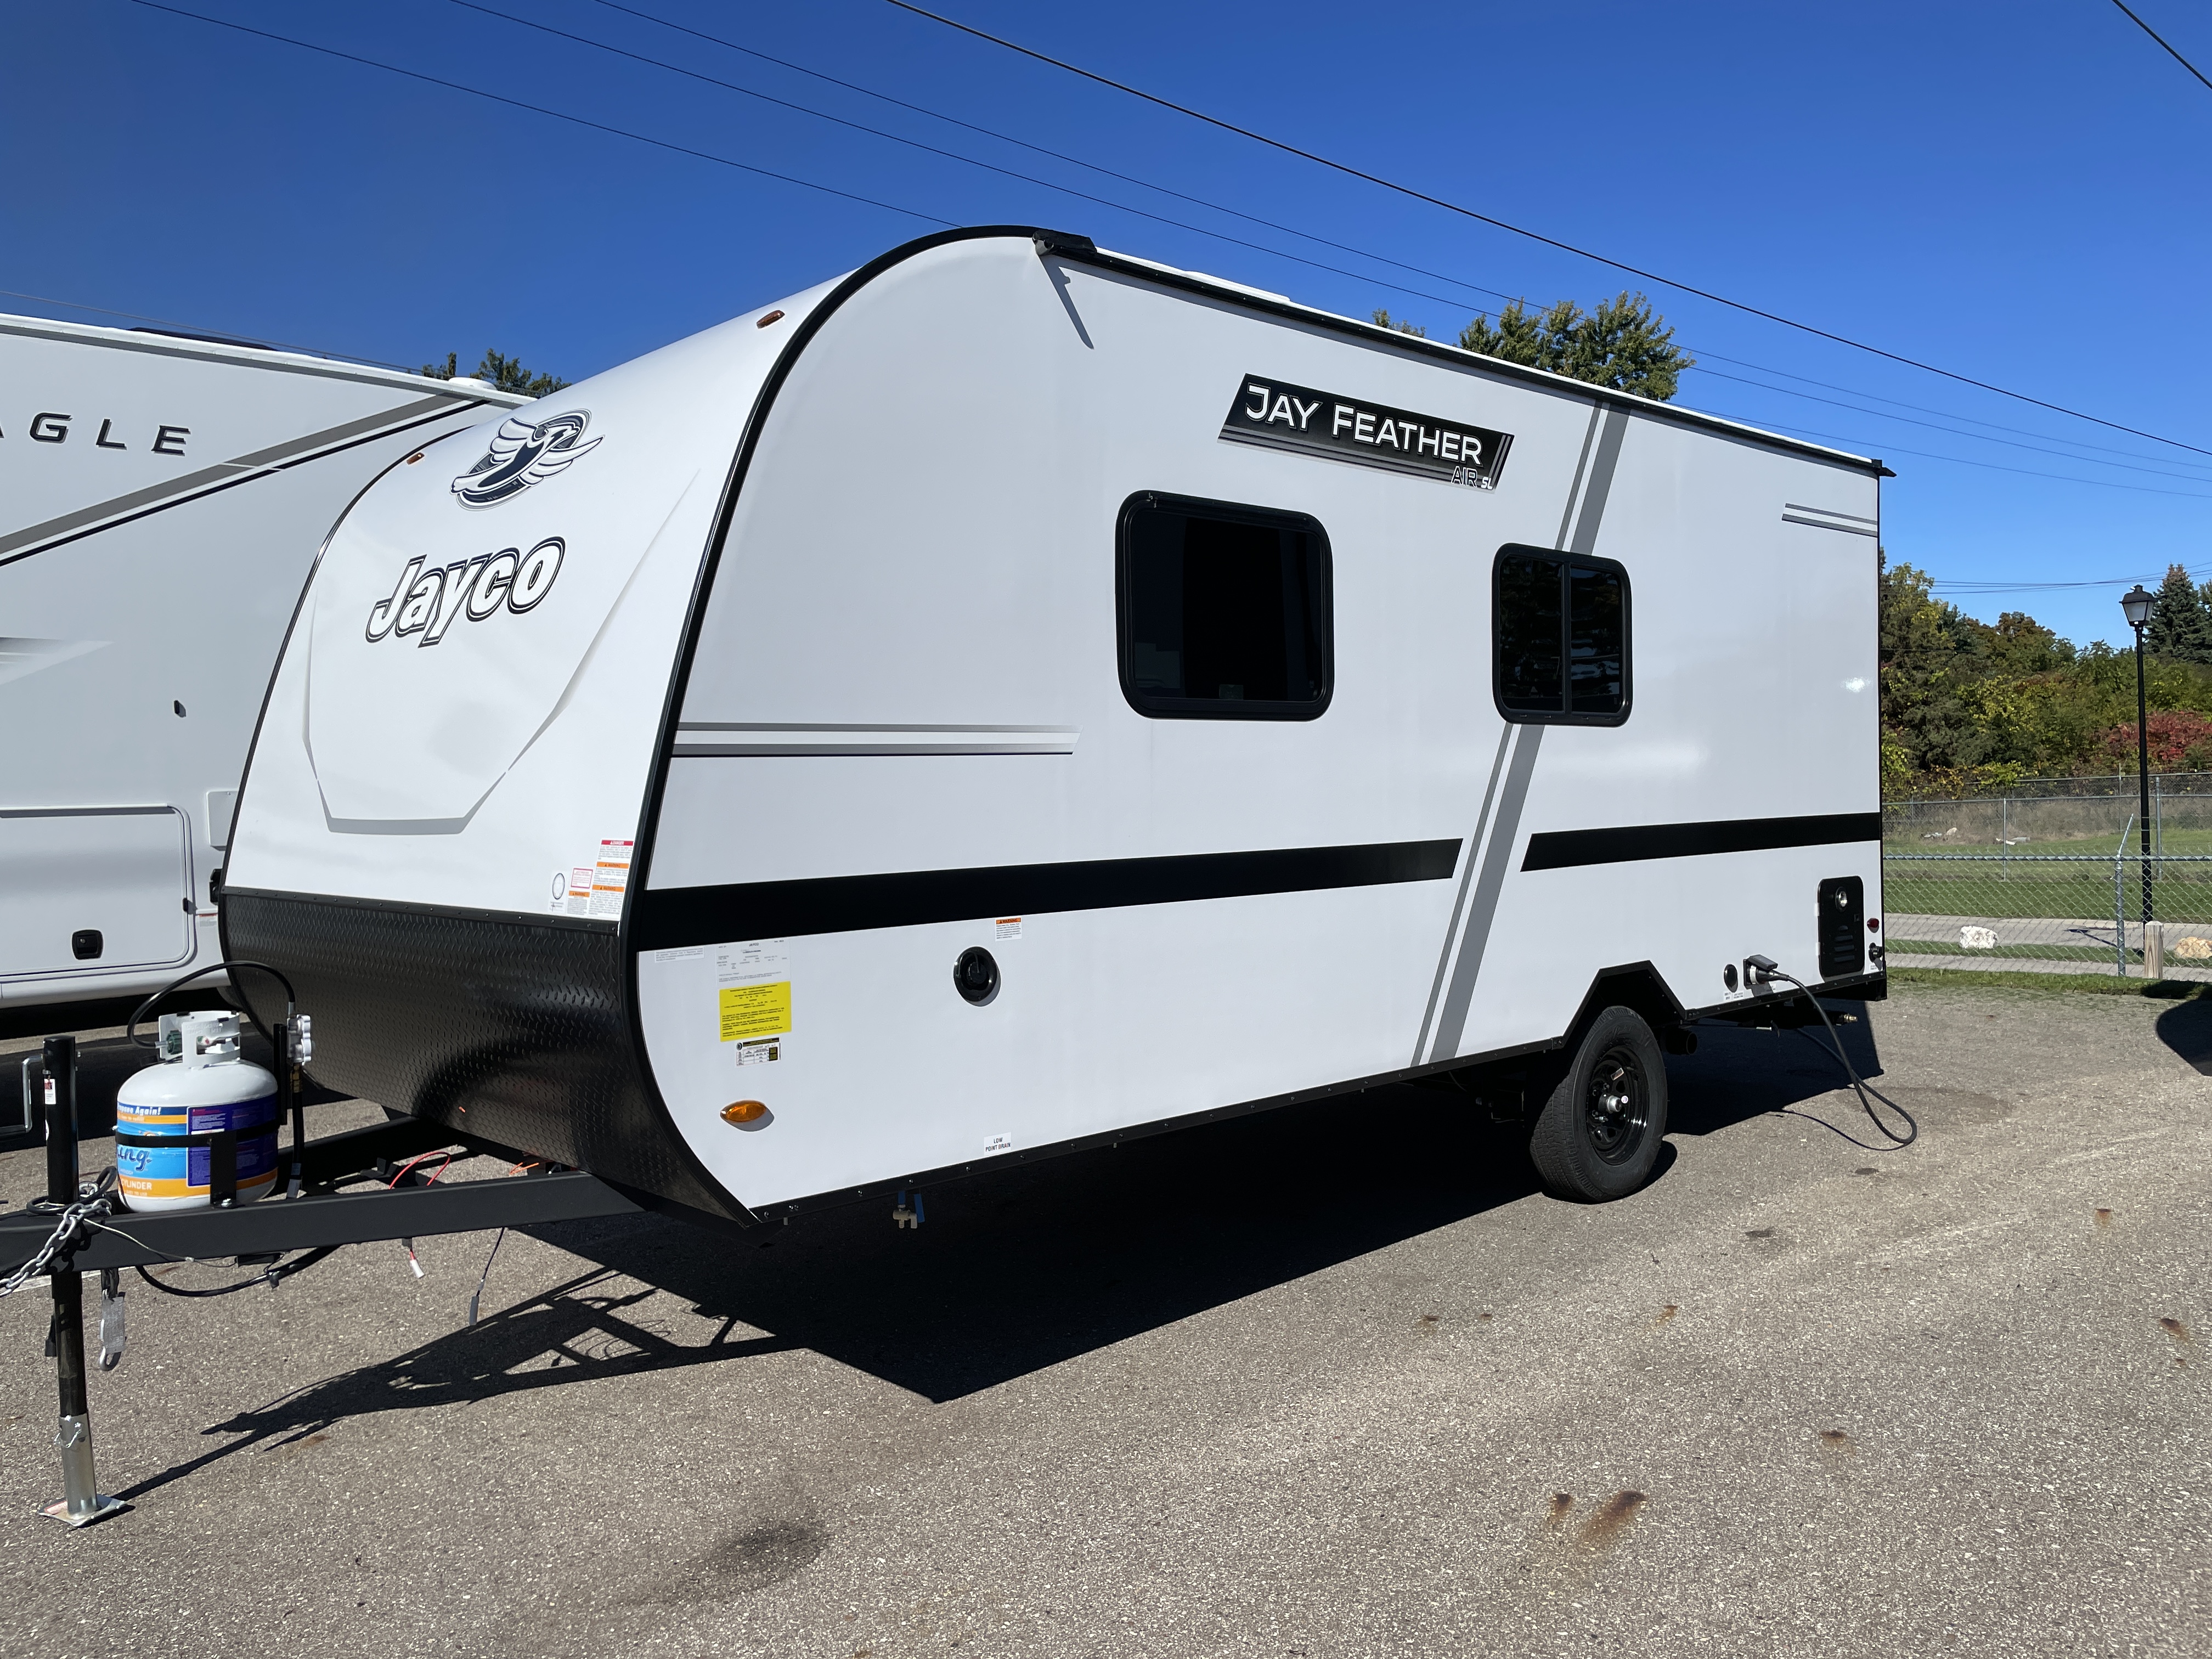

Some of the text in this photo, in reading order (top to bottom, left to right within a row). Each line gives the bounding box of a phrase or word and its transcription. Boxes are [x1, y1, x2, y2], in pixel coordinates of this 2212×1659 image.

[0, 412, 191, 456] GLE
[1245, 382, 1483, 467] JAY FEATHER
[1451, 465, 1493, 490] AIR SL
[365, 536, 566, 648] Jayco
[135, 1105, 162, 1116] Again!
[121, 1178, 153, 1190] CYLINDER
